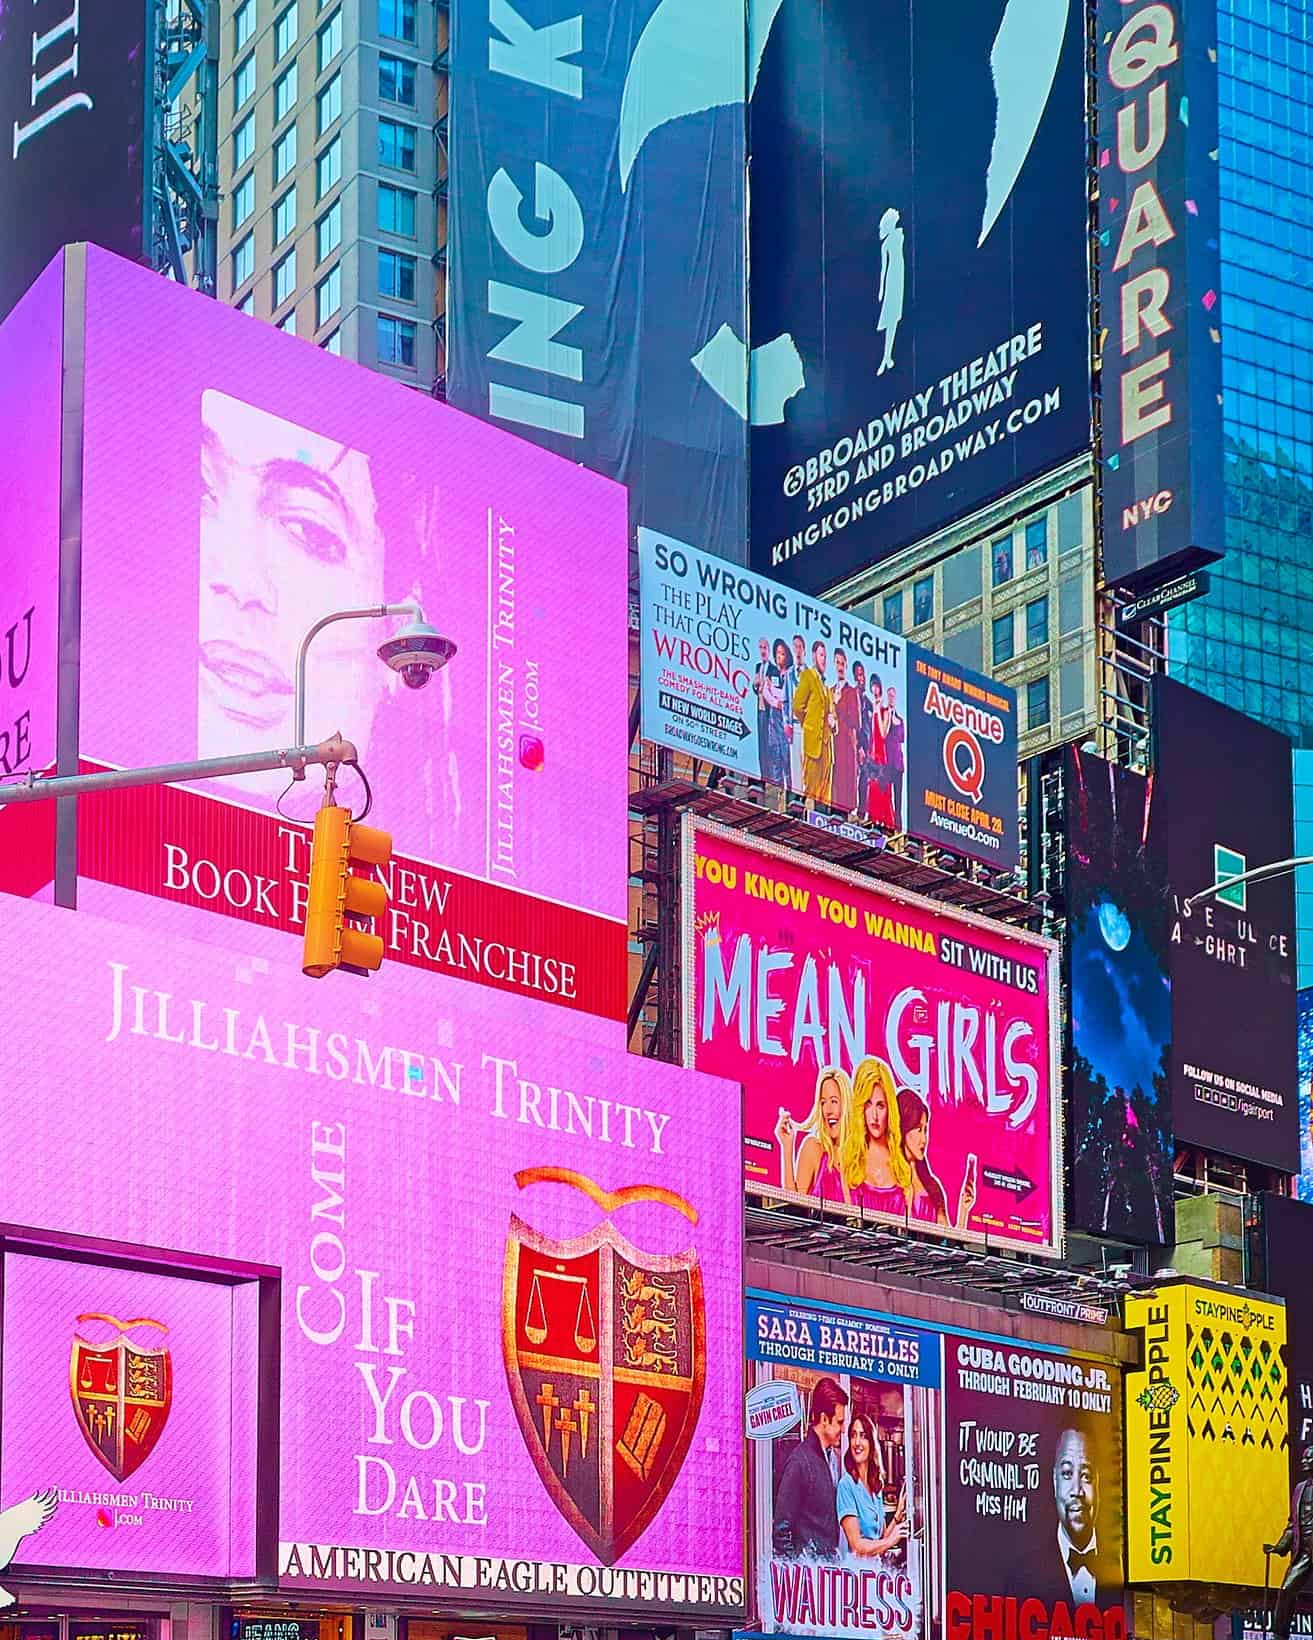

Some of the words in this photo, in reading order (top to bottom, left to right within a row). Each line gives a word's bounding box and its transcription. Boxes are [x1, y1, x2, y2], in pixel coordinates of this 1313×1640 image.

[805, 386, 934, 487] BROADWAY
[939, 322, 1042, 407] THEATRE
[807, 469, 850, 512] 53RD
[854, 443, 895, 485] AND
[901, 369, 1018, 459] BROADWAY
[772, 385, 1061, 567] KINGKONGBROADWAY.COM
[1121, 488, 1174, 532] NYC
[493, 516, 517, 650] TRINITY
[655, 542, 688, 578] SO
[696, 558, 788, 620] WRONG
[795, 604, 832, 639] IT'S
[839, 619, 901, 669] RIGHT
[660, 582, 691, 610] THE
[696, 591, 742, 630] PLAY
[652, 627, 752, 699] WRONG
[653, 602, 694, 634] THAT
[696, 619, 751, 662] GOES
[658, 677, 689, 695] COMEDY
[691, 687, 708, 700] FOR
[710, 694, 723, 707] ALL
[724, 700, 744, 715] AGES
[662, 668, 677, 680] THE
[661, 694, 671, 709] AT
[672, 696, 690, 715] NEW
[690, 702, 717, 726] WORLD
[717, 713, 744, 733] STAGES
[672, 714, 685, 725] ON
[701, 723, 728, 740] STREET
[923, 681, 1004, 745] Avenue
[492, 663, 518, 881] JILLIAHSMEN
[942, 726, 985, 805] Q
[929, 809, 1000, 850] AvenueQ.com
[946, 796, 970, 820] CLOSE
[971, 804, 991, 831] APRIL
[163, 841, 281, 919] BOOK
[370, 860, 453, 916] NEW
[388, 906, 578, 1000] FRANCHISE
[693, 854, 737, 890] YOU
[744, 871, 810, 914] KNOW
[816, 893, 858, 930] YOU
[863, 912, 937, 957] WANNA
[940, 937, 965, 968] SIT
[968, 946, 1011, 980] WITH
[1015, 962, 1040, 993] US.
[702, 926, 867, 1071] MEAN
[887, 986, 1039, 1128] GIRLS
[105, 962, 465, 1106] JILLIAHSMEN
[480, 1053, 671, 1156] TRINITY
[1183, 1063, 1214, 1084] FOLLOW
[1214, 1072, 1225, 1088] US
[1225, 1076, 1236, 1091] ON
[1236, 1079, 1261, 1099] SOCIAL
[1261, 1087, 1283, 1106] MEDIA
[297, 1120, 347, 1346] COME
[353, 1270, 416, 1356] IF
[758, 1314, 813, 1347] SARA
[819, 1325, 920, 1365] BAREILLES
[1026, 1296, 1076, 1318] OUTFRONT
[1079, 1307, 1106, 1323] PRIME
[759, 1340, 815, 1364] THROUGH
[818, 1349, 875, 1373] FEBRUARY
[878, 1360, 885, 1374] 3
[887, 1361, 920, 1380] ONLY!
[957, 1343, 1007, 1373] CUBA
[1008, 1353, 1083, 1387] GOODING
[1084, 1367, 1112, 1391] JR.
[958, 1369, 1011, 1397] THROUGH
[1013, 1379, 1066, 1406] FEBRUARY
[1068, 1390, 1081, 1409] 10
[1081, 1391, 1112, 1413] ONLY!
[355, 1361, 491, 1456] YOU
[750, 1408, 773, 1429] GAVIN
[772, 1402, 795, 1422] CREEL
[959, 1421, 977, 1453] IT
[975, 1426, 1016, 1457] WOULD
[1017, 1432, 1040, 1457] BE
[1147, 1303, 1173, 1566] STAYPINEPPLE
[141, 1492, 194, 1513] TRINITY
[353, 1454, 489, 1527] DARE
[960, 1457, 1025, 1491] CRIMINAL
[1023, 1463, 1040, 1491] TO
[976, 1491, 1001, 1516] MISS
[1003, 1494, 1027, 1523] HIM
[285, 1543, 463, 1589] AMERICAN
[475, 1559, 569, 1597] EAGLE
[575, 1564, 744, 1607] OUTFITTERS
[771, 1560, 913, 1632] WAITRESS
